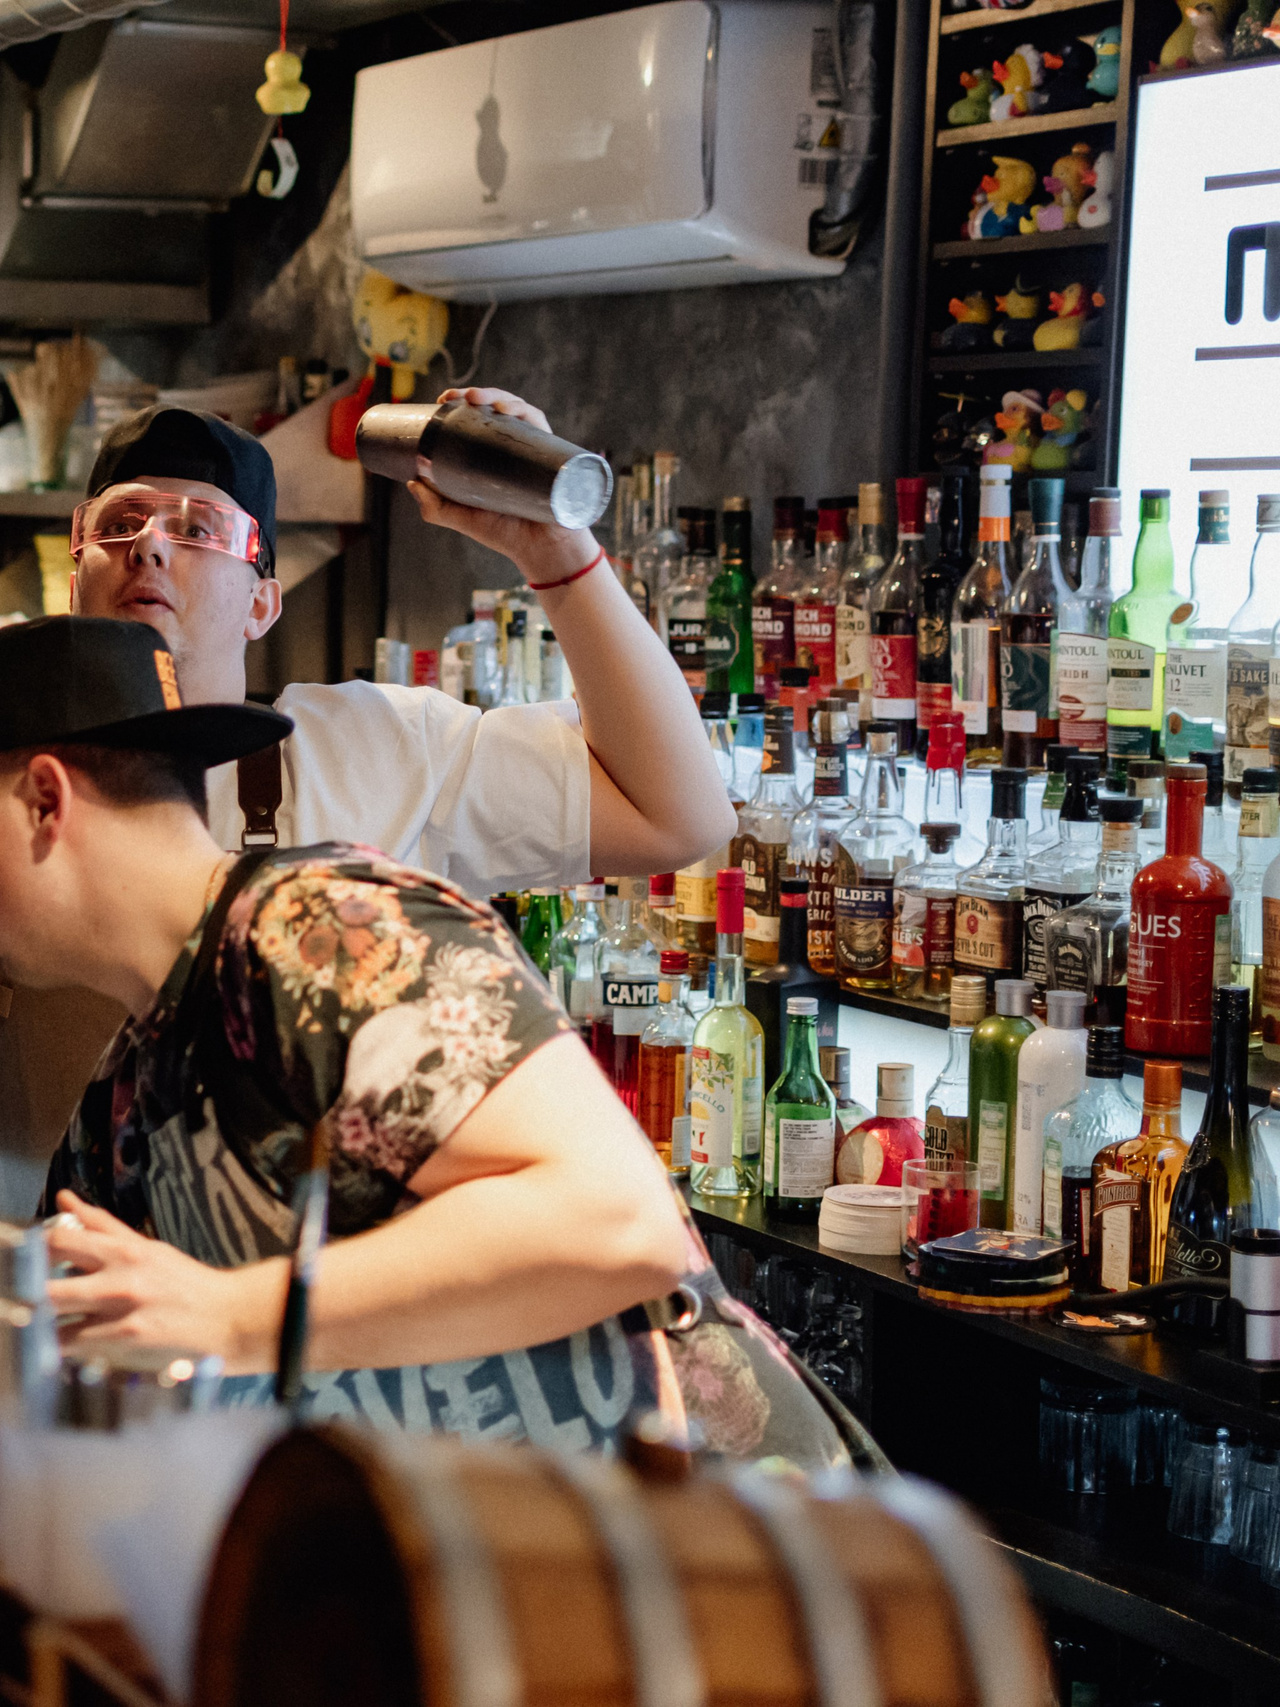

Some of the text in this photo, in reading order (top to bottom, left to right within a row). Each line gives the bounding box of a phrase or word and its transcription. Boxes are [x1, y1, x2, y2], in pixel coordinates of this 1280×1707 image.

[669, 623, 707, 637] JUR
[834, 886, 887, 902] ULDER
[979, 941, 995, 958] CUT
[1097, 1184, 1138, 1210] COINTREAU
